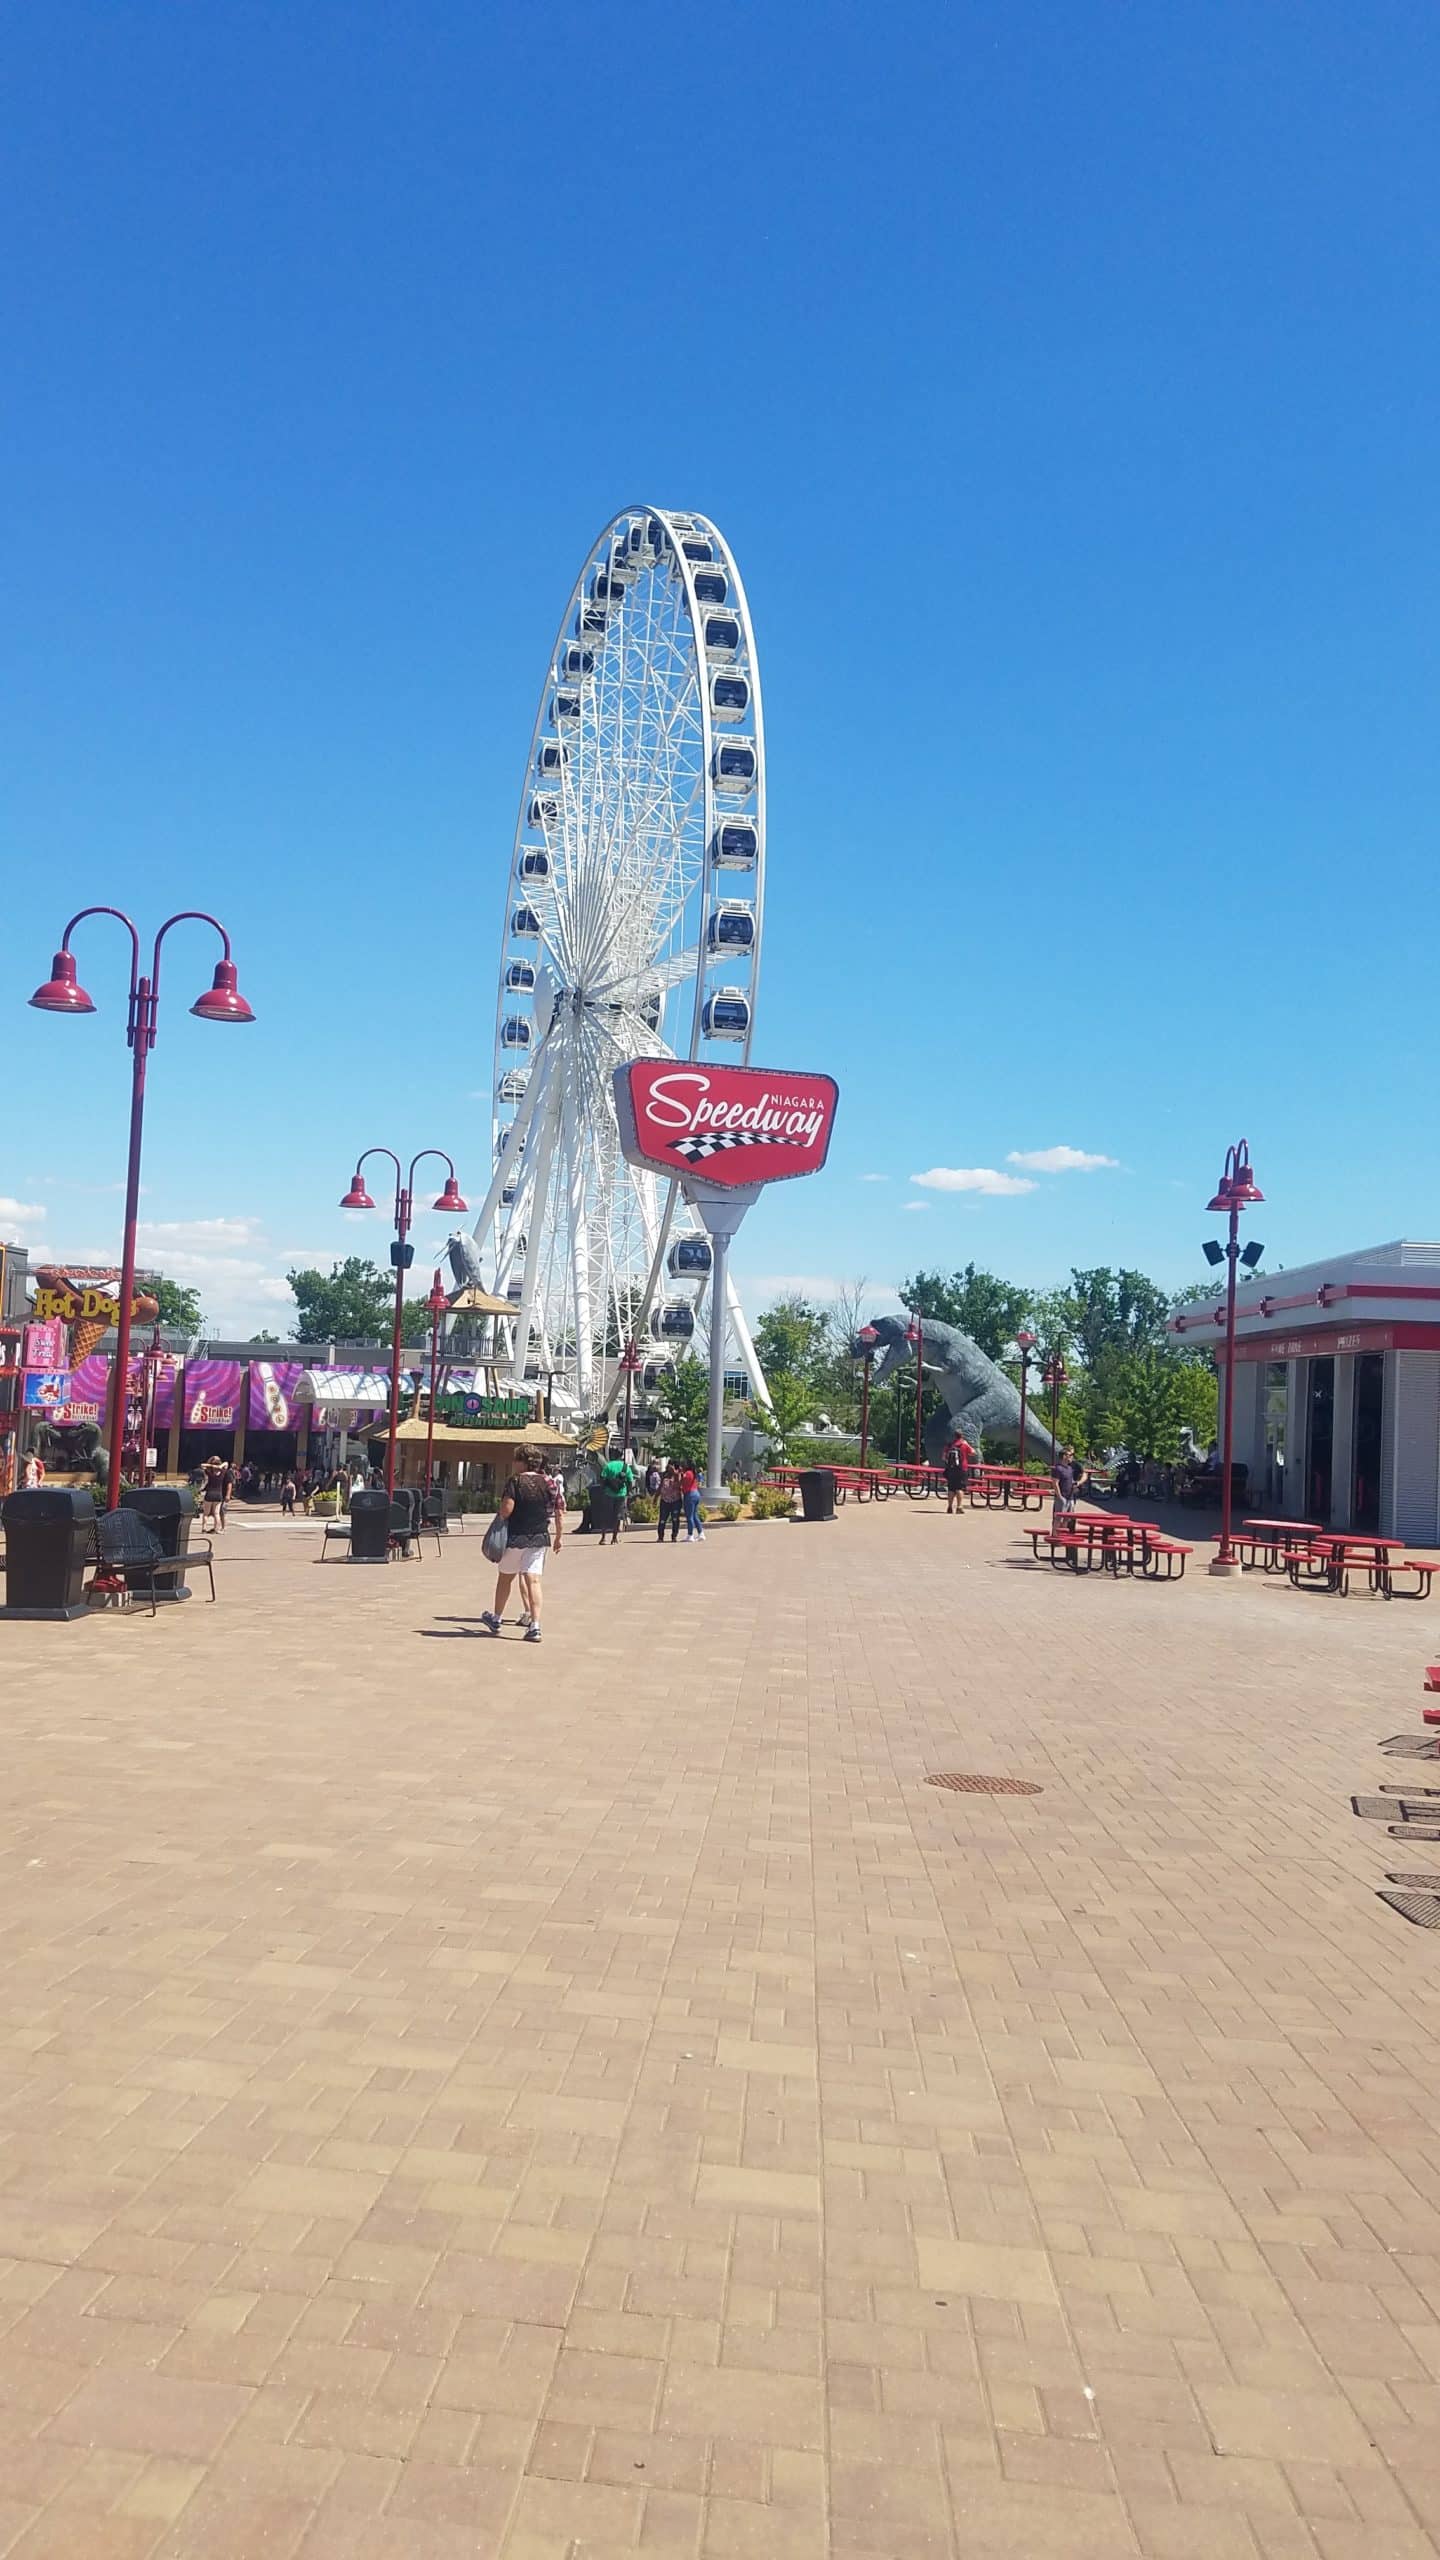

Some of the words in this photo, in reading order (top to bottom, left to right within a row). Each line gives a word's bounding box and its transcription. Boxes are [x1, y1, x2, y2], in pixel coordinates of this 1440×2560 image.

[771, 1094, 824, 1110] NIAGARA
[645, 1073, 825, 1148] Speedway
[33, 1287, 75, 1320] Hot
[63, 1403, 97, 1419] Strike!
[200, 1406, 232, 1422] Strike!
